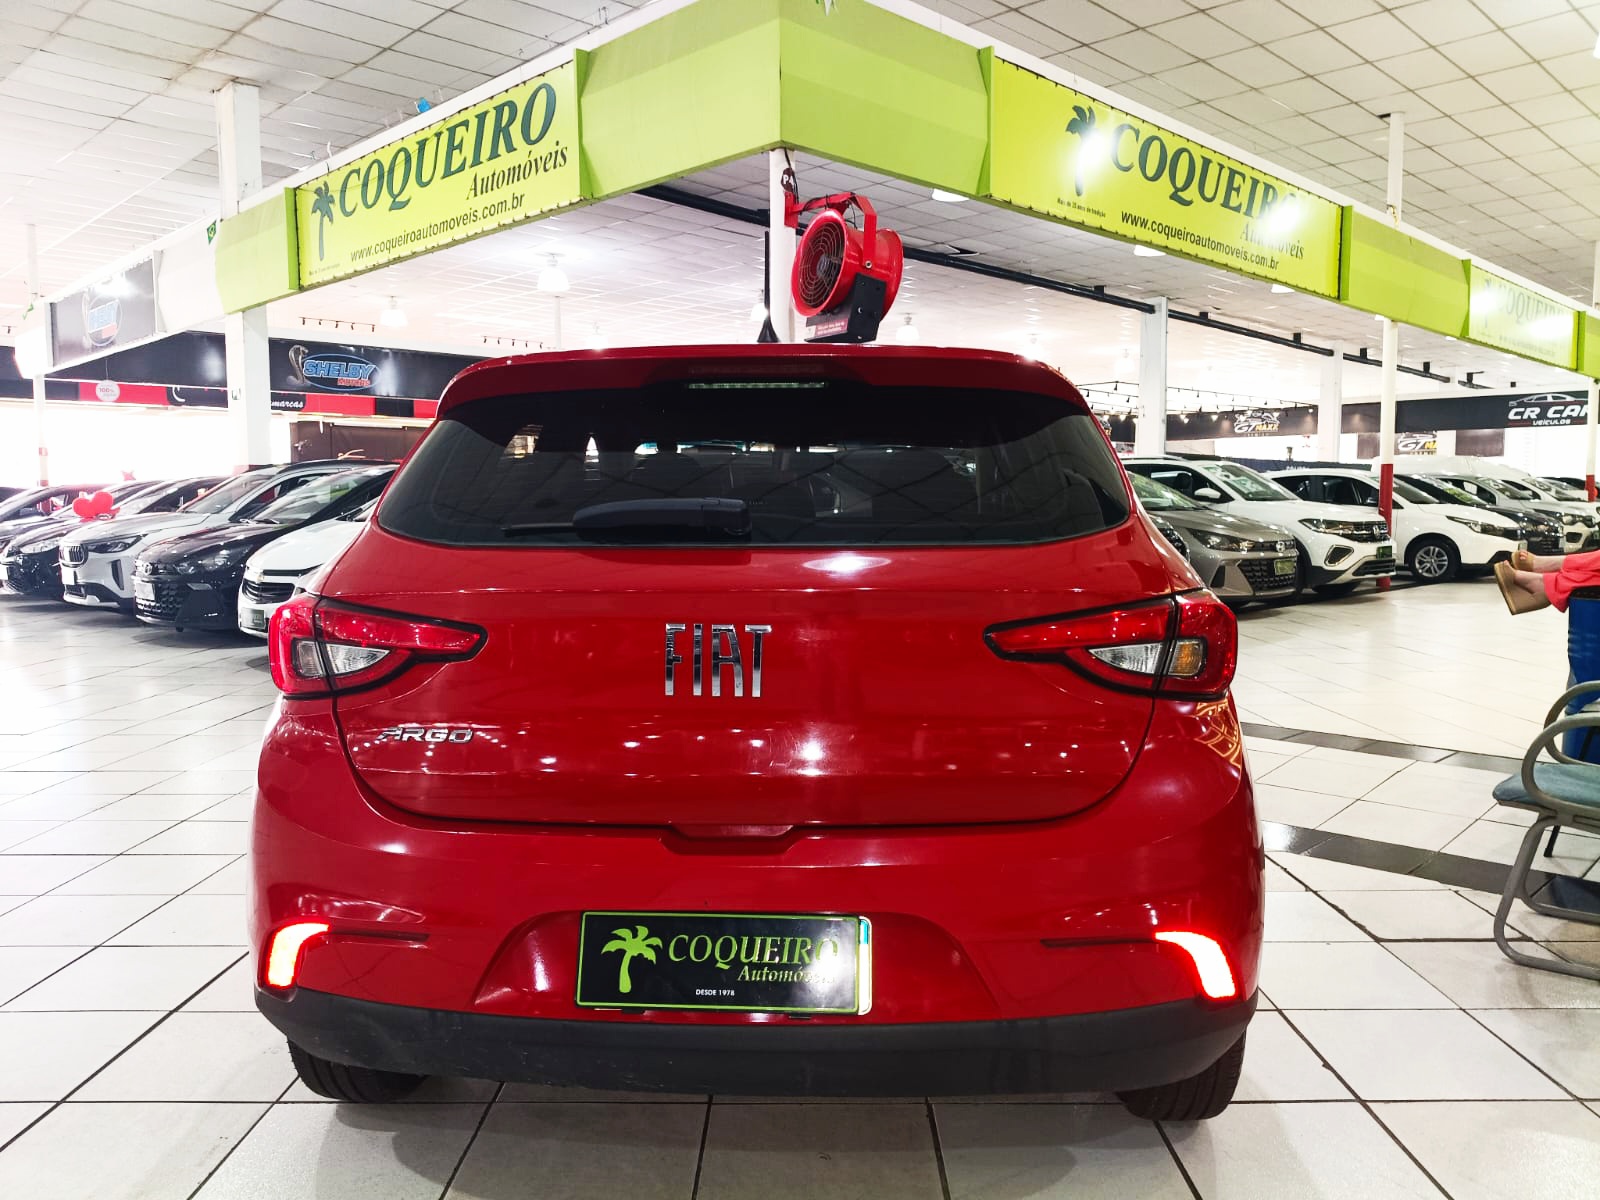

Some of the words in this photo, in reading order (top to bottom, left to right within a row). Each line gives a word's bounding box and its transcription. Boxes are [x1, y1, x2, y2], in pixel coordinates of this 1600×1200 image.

[339, 83, 557, 217] COQUEIRO
[466, 140, 568, 200] Automóveis
[350, 193, 525, 262] www.coqueiroautomoveis.com.br
[1121, 210, 1280, 271] www.coqueiroautomoveis.com.br
[303, 360, 377, 381] SHELBY
[271, 400, 304, 409] marcas
[1508, 407, 1541, 420] CR
[665, 623, 772, 698] FIAT
[376, 727, 472, 744] ARGO
[669, 935, 839, 970] COQUEIRO
[737, 965, 835, 985] Automó
[695, 988, 716, 997] DESDE
